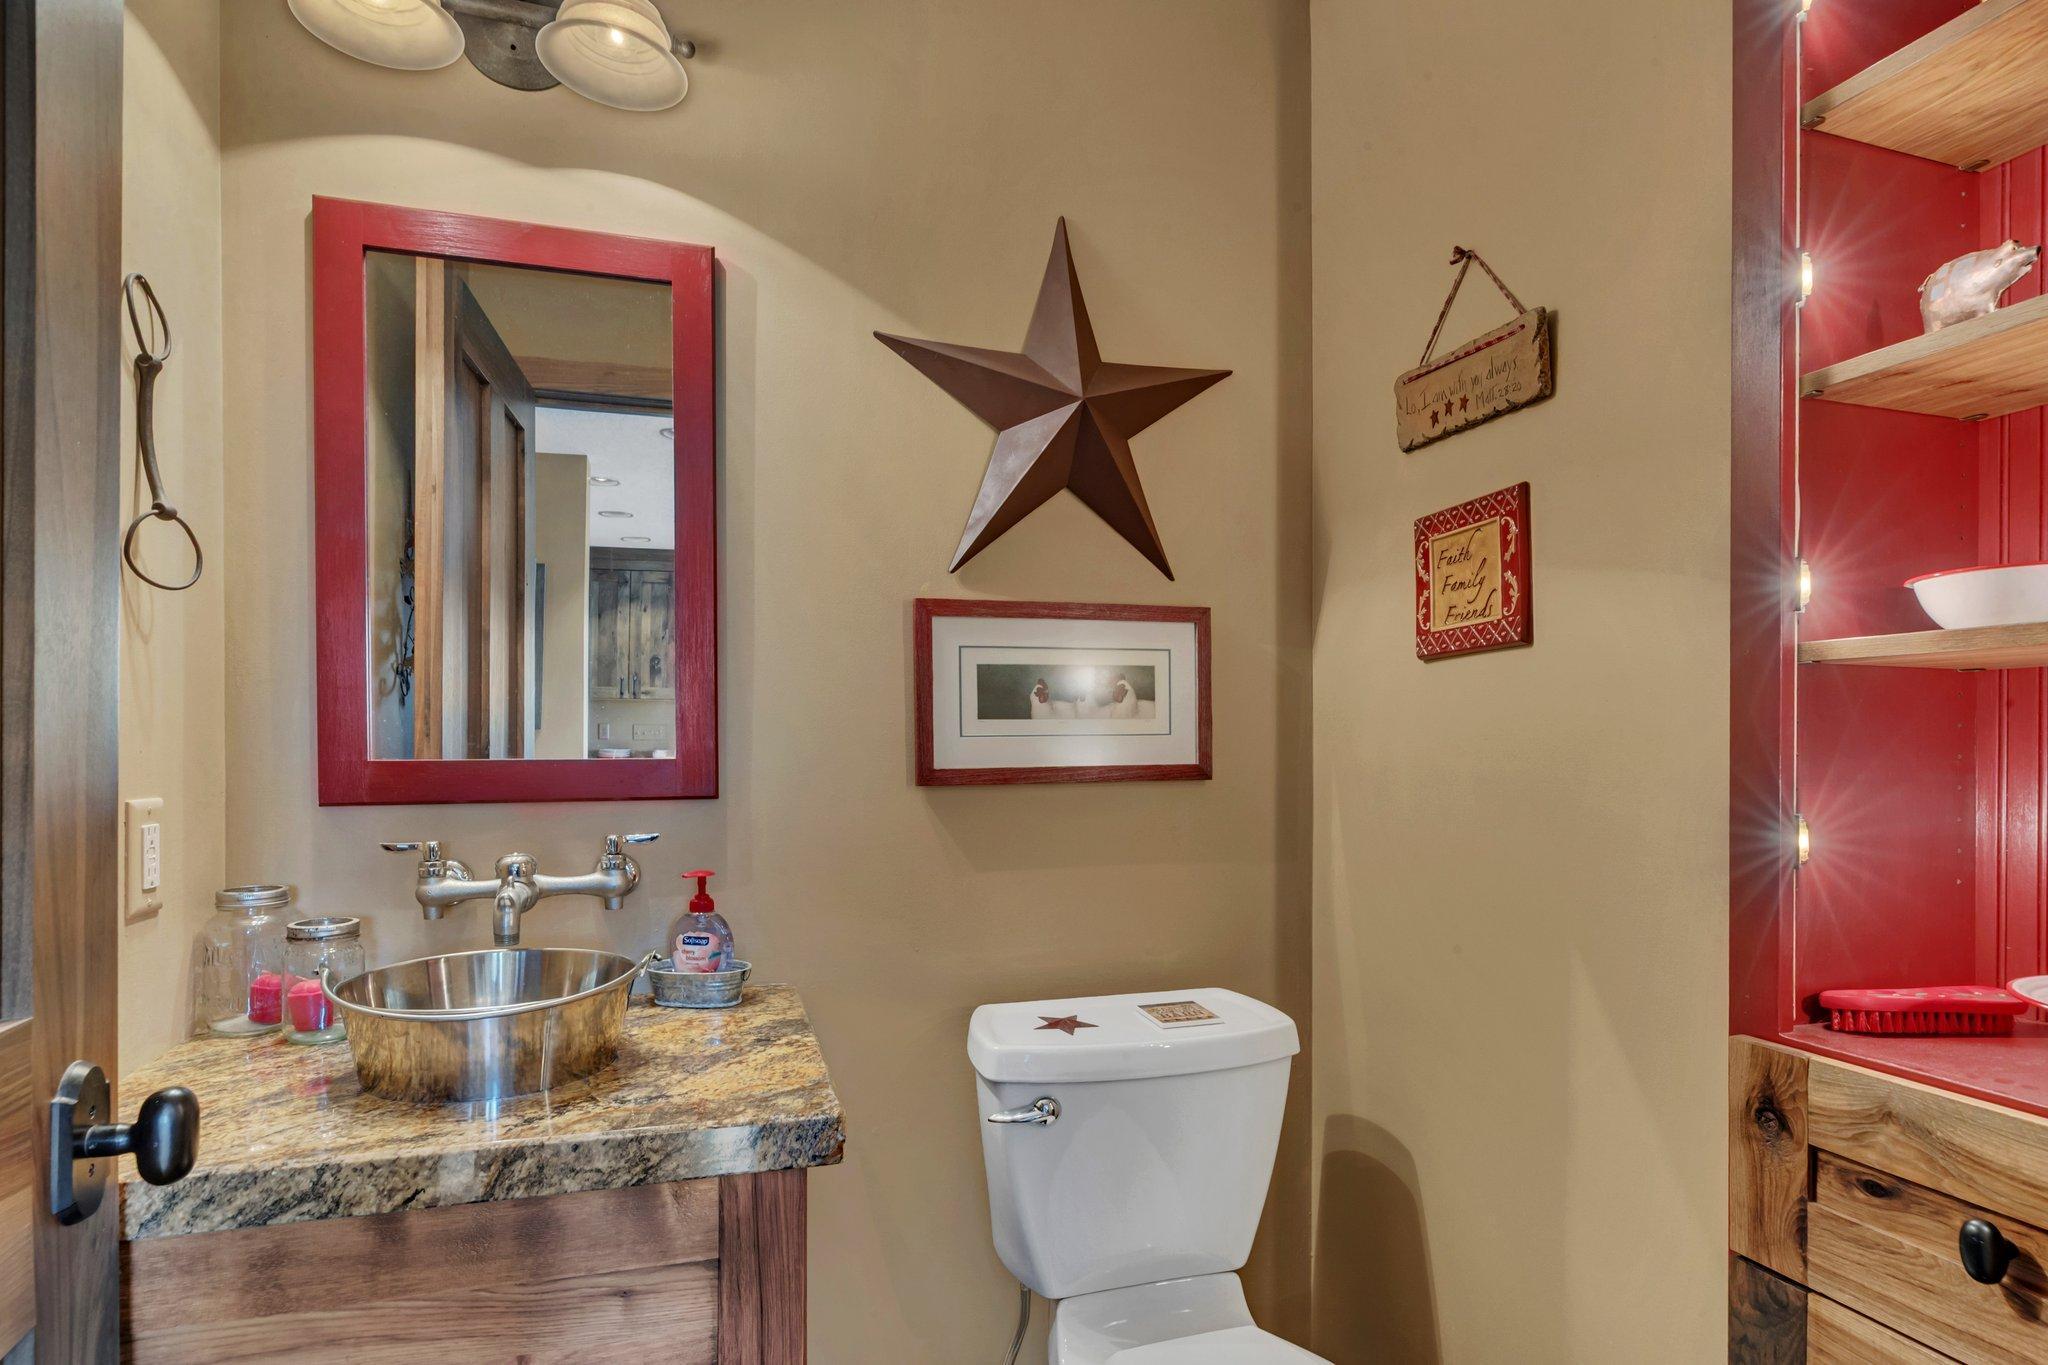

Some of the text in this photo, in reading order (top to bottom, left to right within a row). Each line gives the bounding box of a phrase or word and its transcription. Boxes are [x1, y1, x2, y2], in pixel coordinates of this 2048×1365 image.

[1420, 390, 1431, 411] I
[1432, 390, 1448, 403] am
[1437, 528, 1483, 569] Faith
[1441, 558, 1487, 604] Family
[1445, 589, 1497, 625] Friends
[683, 936, 708, 946] Softsoap
